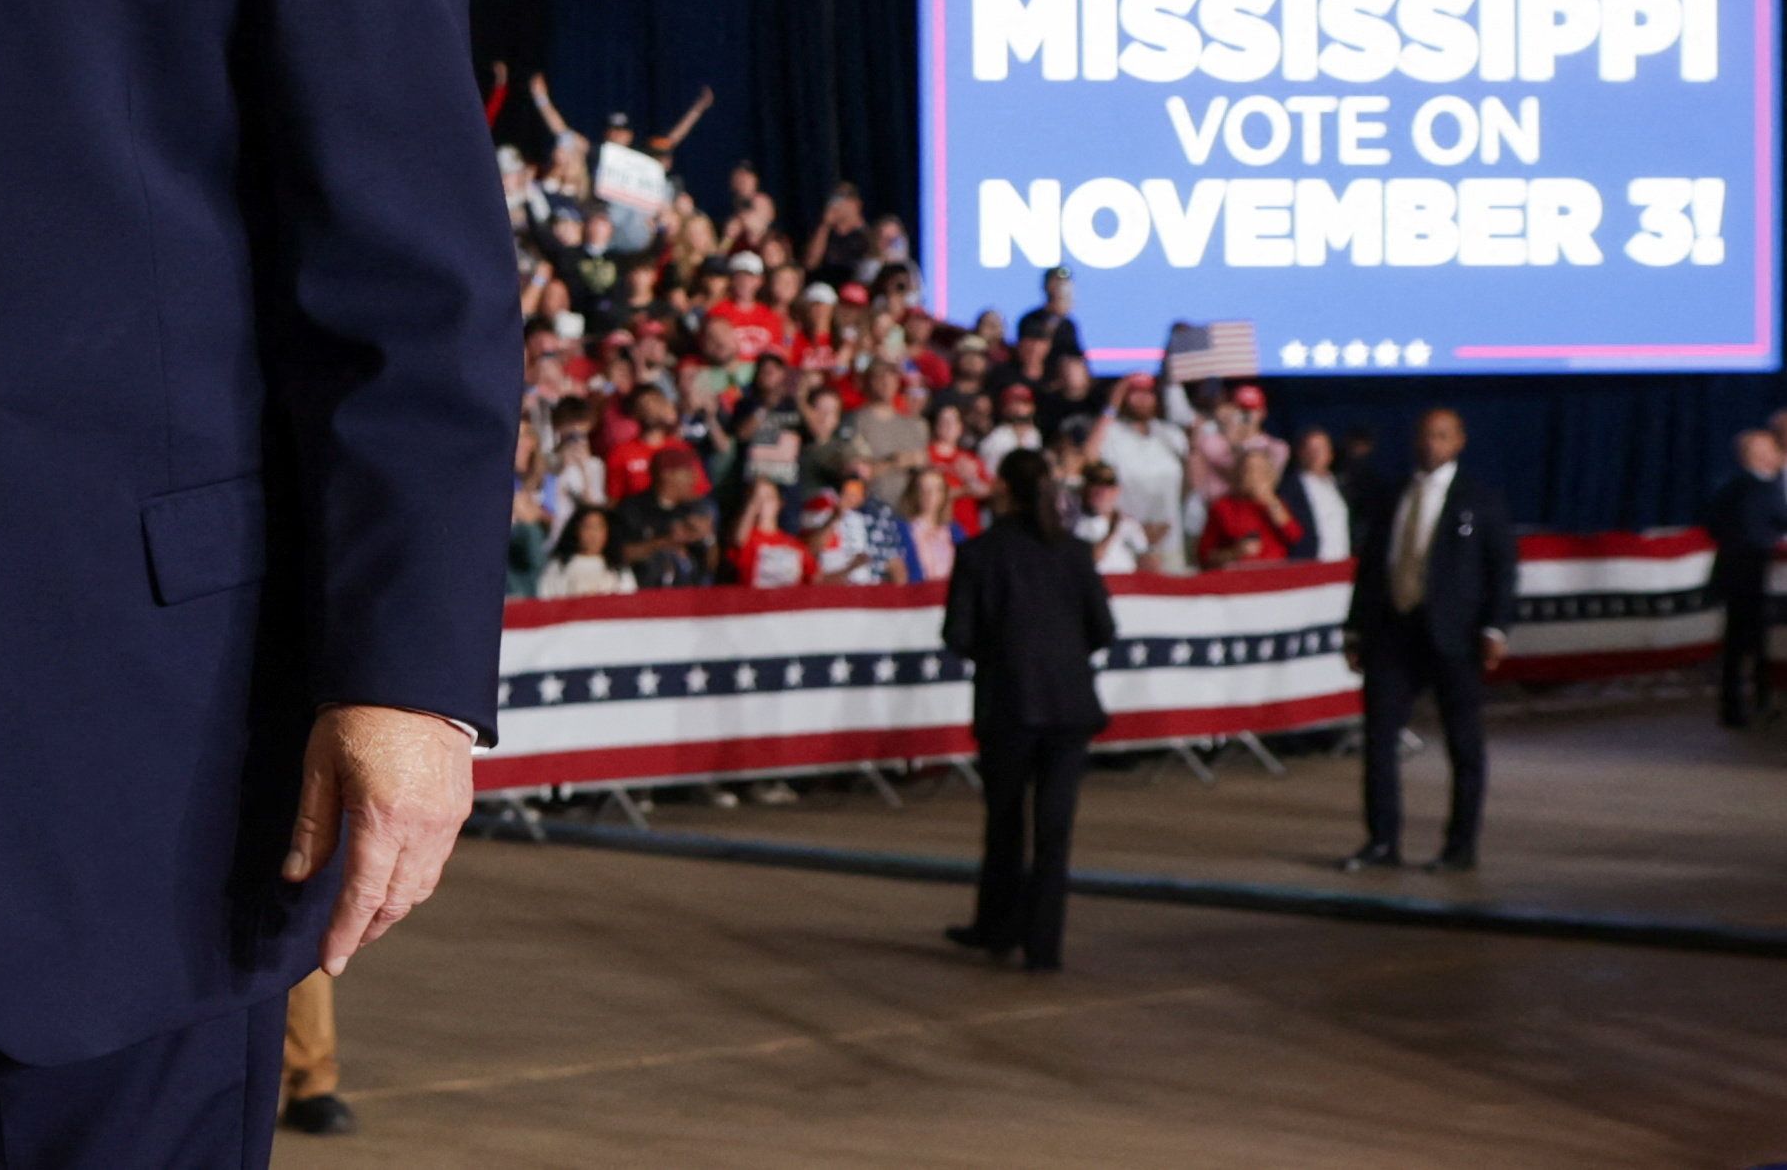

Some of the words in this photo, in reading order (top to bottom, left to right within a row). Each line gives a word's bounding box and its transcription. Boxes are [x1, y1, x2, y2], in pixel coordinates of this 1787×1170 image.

[1165, 95, 1391, 166] VOTE
[1411, 95, 1540, 166] ON
[978, 177, 1604, 269] NOVEMBER
[1624, 177, 1726, 267] 3!
